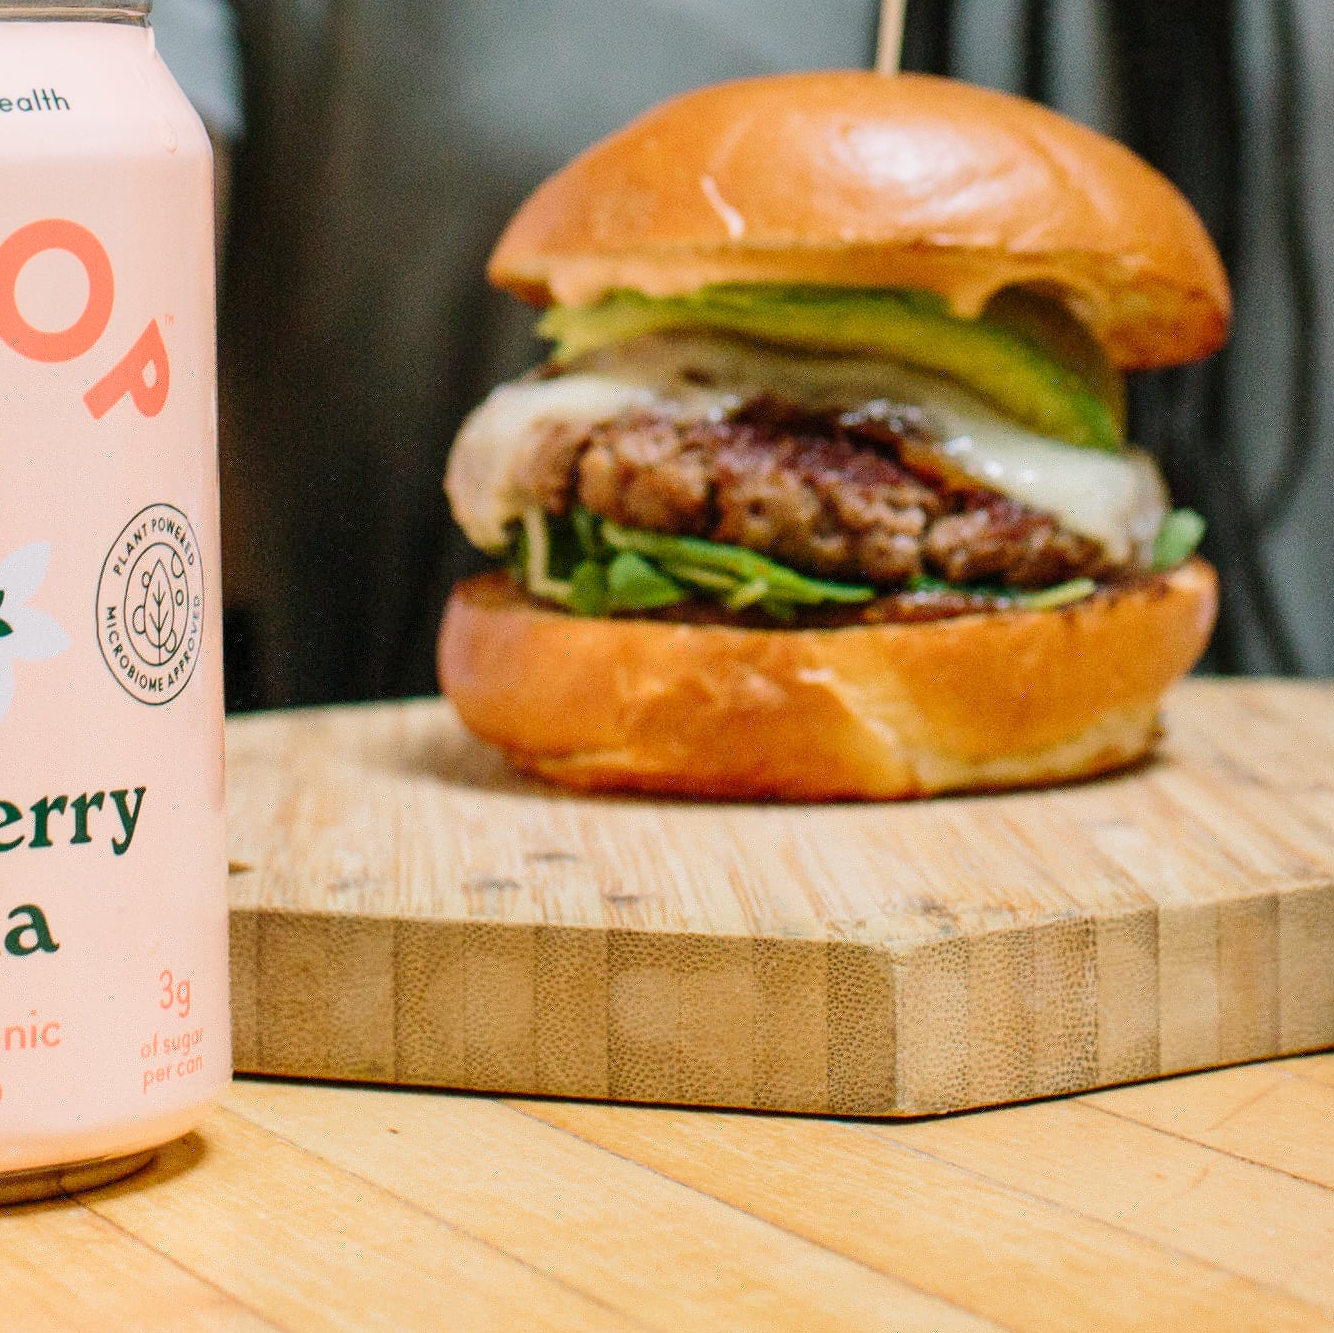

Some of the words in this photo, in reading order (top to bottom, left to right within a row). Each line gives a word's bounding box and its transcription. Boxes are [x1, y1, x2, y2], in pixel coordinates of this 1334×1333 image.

[113, 525, 148, 576] PLANT
[151, 517, 195, 566] POWERED
[106, 606, 164, 692] MICROBIOME
[168, 596, 200, 686] APPROVED
[159, 969, 191, 1018] 3g
[140, 1031, 160, 1060] of
[163, 1027, 204, 1054] sugar
[142, 1067, 172, 1095] per
[176, 1056, 203, 1077] can
